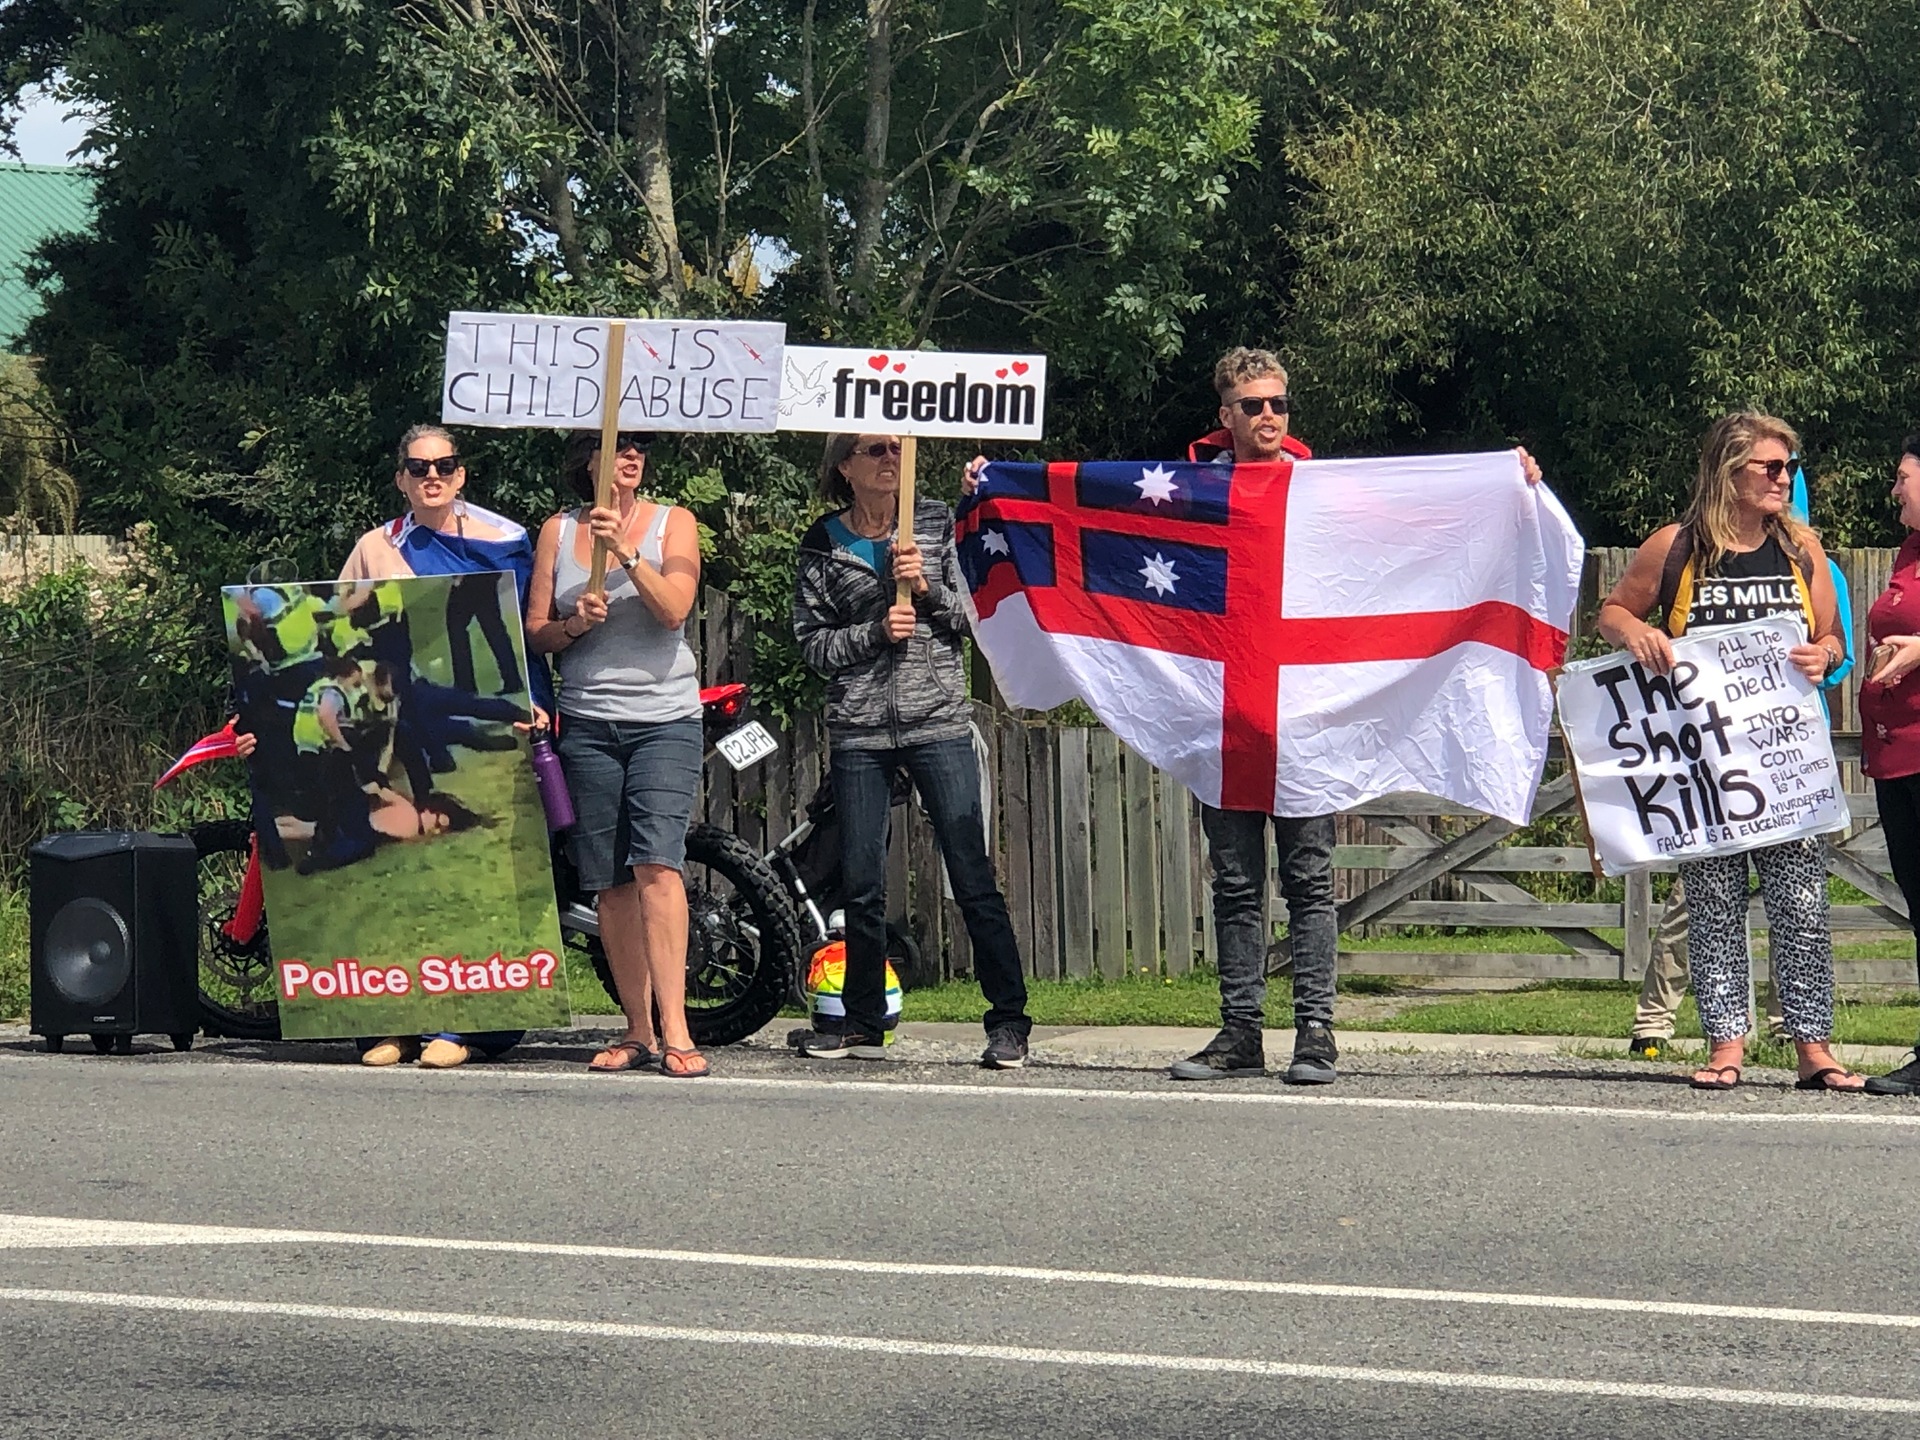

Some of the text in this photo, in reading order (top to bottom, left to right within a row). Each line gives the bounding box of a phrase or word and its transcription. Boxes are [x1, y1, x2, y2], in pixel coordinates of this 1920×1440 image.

[461, 322, 720, 371] THIS IS
[448, 372, 769, 420] CHILD ABUSE
[832, 368, 1036, 425] freedom
[1733, 584, 1804, 605] MILLS
[1718, 630, 1782, 657] ALL The
[1720, 645, 1787, 674] Labrats
[1592, 660, 1705, 722] The
[1724, 661, 1786, 703] Died!
[1608, 700, 1733, 768] Shot
[1742, 705, 1800, 734] INFO
[1748, 721, 1816, 750] WARS.
[724, 725, 773, 764] C2JPH
[1795, 778, 1807, 790] A
[1799, 757, 1830, 775] GATES
[1623, 758, 1766, 836] Kills
[1657, 830, 1697, 853] FAUCI
[1722, 826, 1735, 841] A
[1739, 810, 1802, 837] EUGENIST!
[280, 950, 558, 999] Police State?
